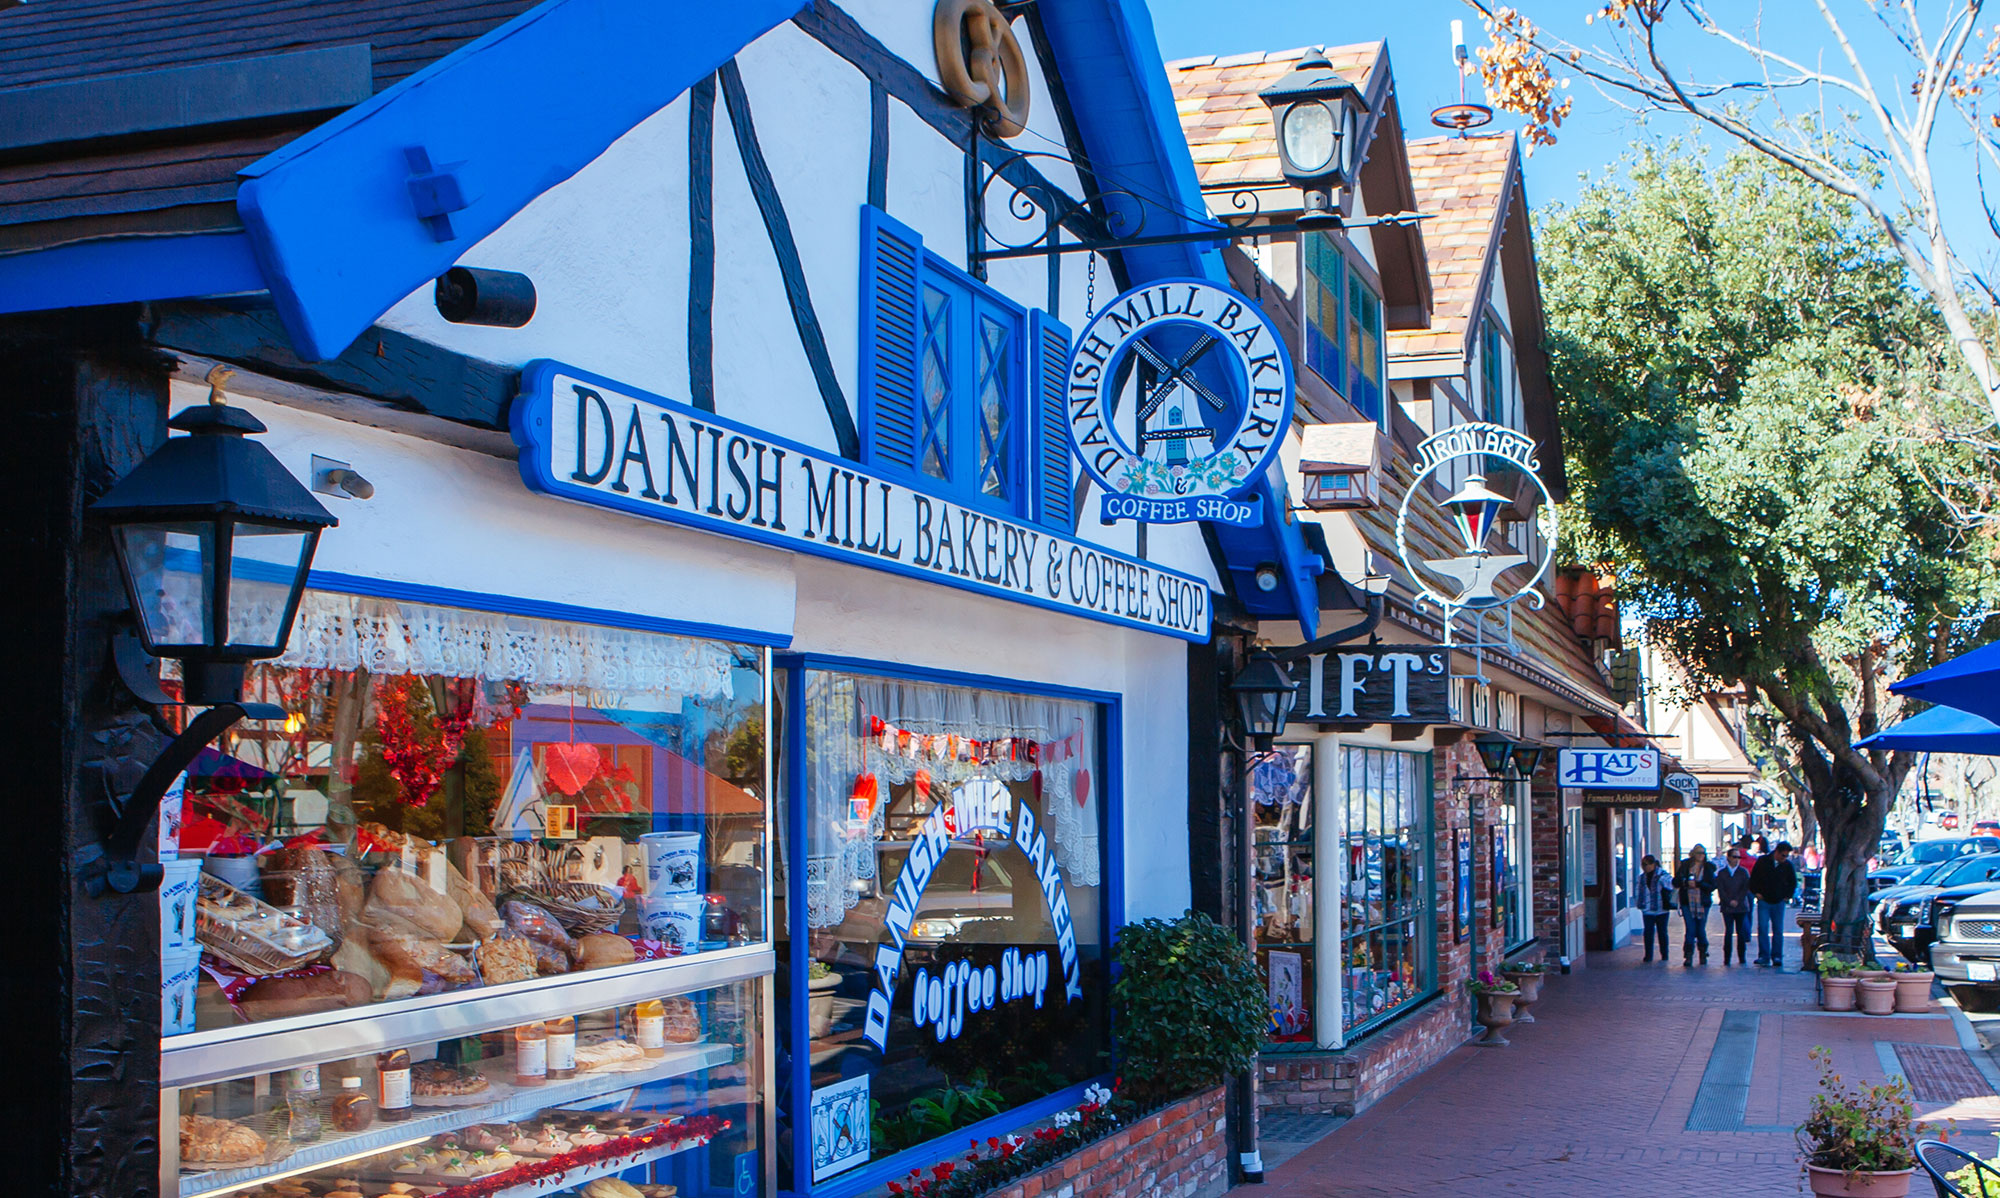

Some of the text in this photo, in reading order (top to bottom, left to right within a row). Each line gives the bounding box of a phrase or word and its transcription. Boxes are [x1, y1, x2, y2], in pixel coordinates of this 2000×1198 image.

[1069, 285, 1284, 479] DANISH MILL BAKERY
[1425, 431, 1529, 465] IRON ART
[1175, 477, 1188, 495] &
[571, 383, 1204, 633] DANISH MILL BAKERY & COFFEE SHOP
[1107, 498, 1252, 524] COFFEE SHOP
[1565, 752, 1652, 783] HATS
[1669, 778, 1694, 788] SOCK
[863, 779, 1083, 1054] DANISH MILL BAKERY
[913, 946, 1048, 1043] Coffee Shop
